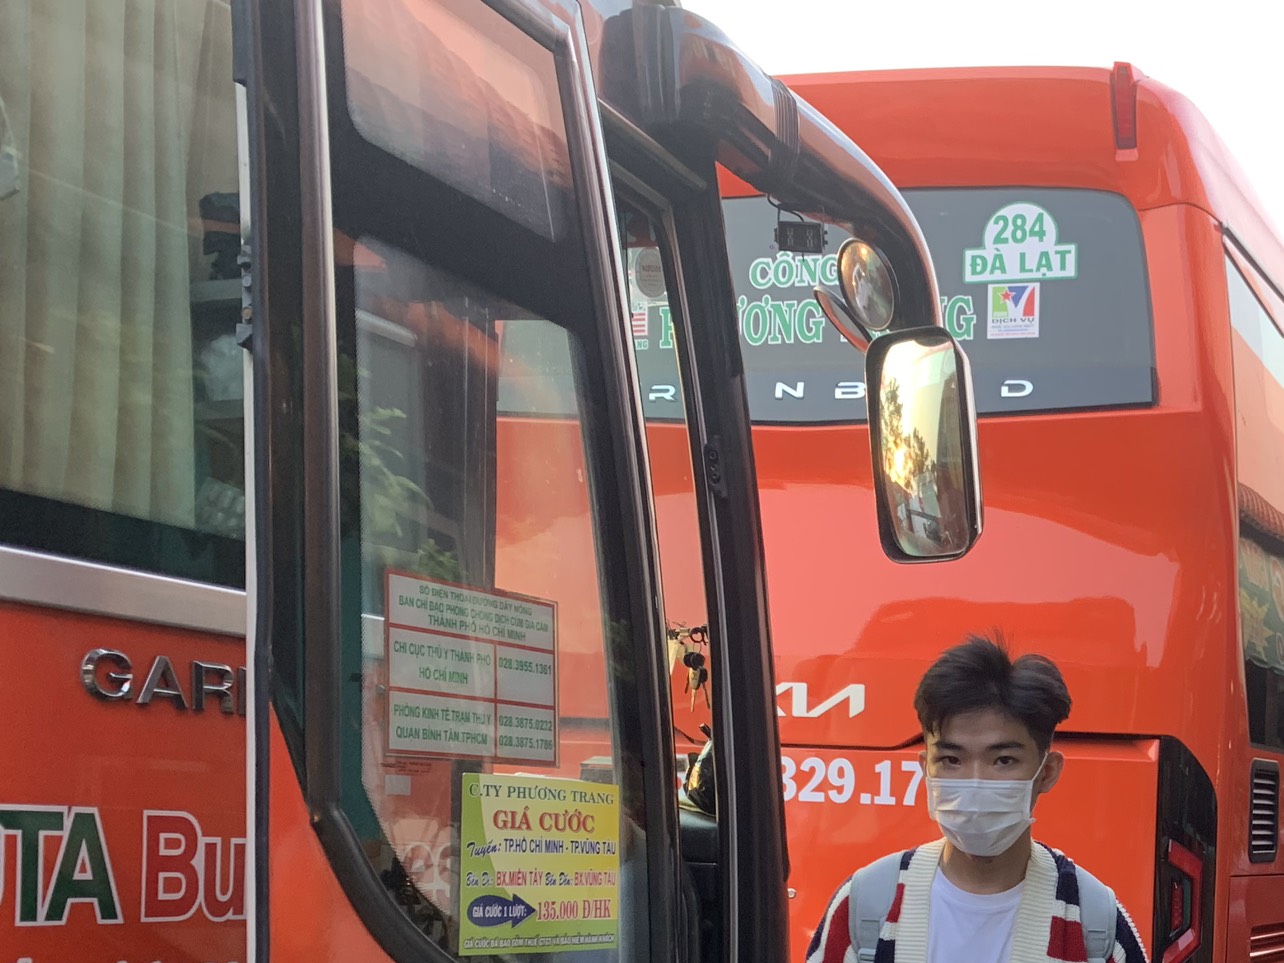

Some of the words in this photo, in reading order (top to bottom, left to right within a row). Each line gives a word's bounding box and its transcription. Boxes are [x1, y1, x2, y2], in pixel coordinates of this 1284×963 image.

[993, 212, 1046, 244] 284
[748, 251, 840, 289] CÔNG
[969, 247, 1007, 276] ĐÀ
[1019, 250, 1072, 277] LẠT
[469, 783, 502, 798] C.TY
[507, 785, 567, 801] PHƯƠNG
[570, 790, 614, 805] TRANG
[492, 806, 532, 831] GIÁ
[539, 808, 596, 833] CƯỚC
[529, 836, 544, 853] CHÍ
[544, 839, 565, 853] MINH
[0, 804, 123, 926] TA
[537, 900, 579, 920] 135.000
[581, 899, 612, 919] Đ/HK
